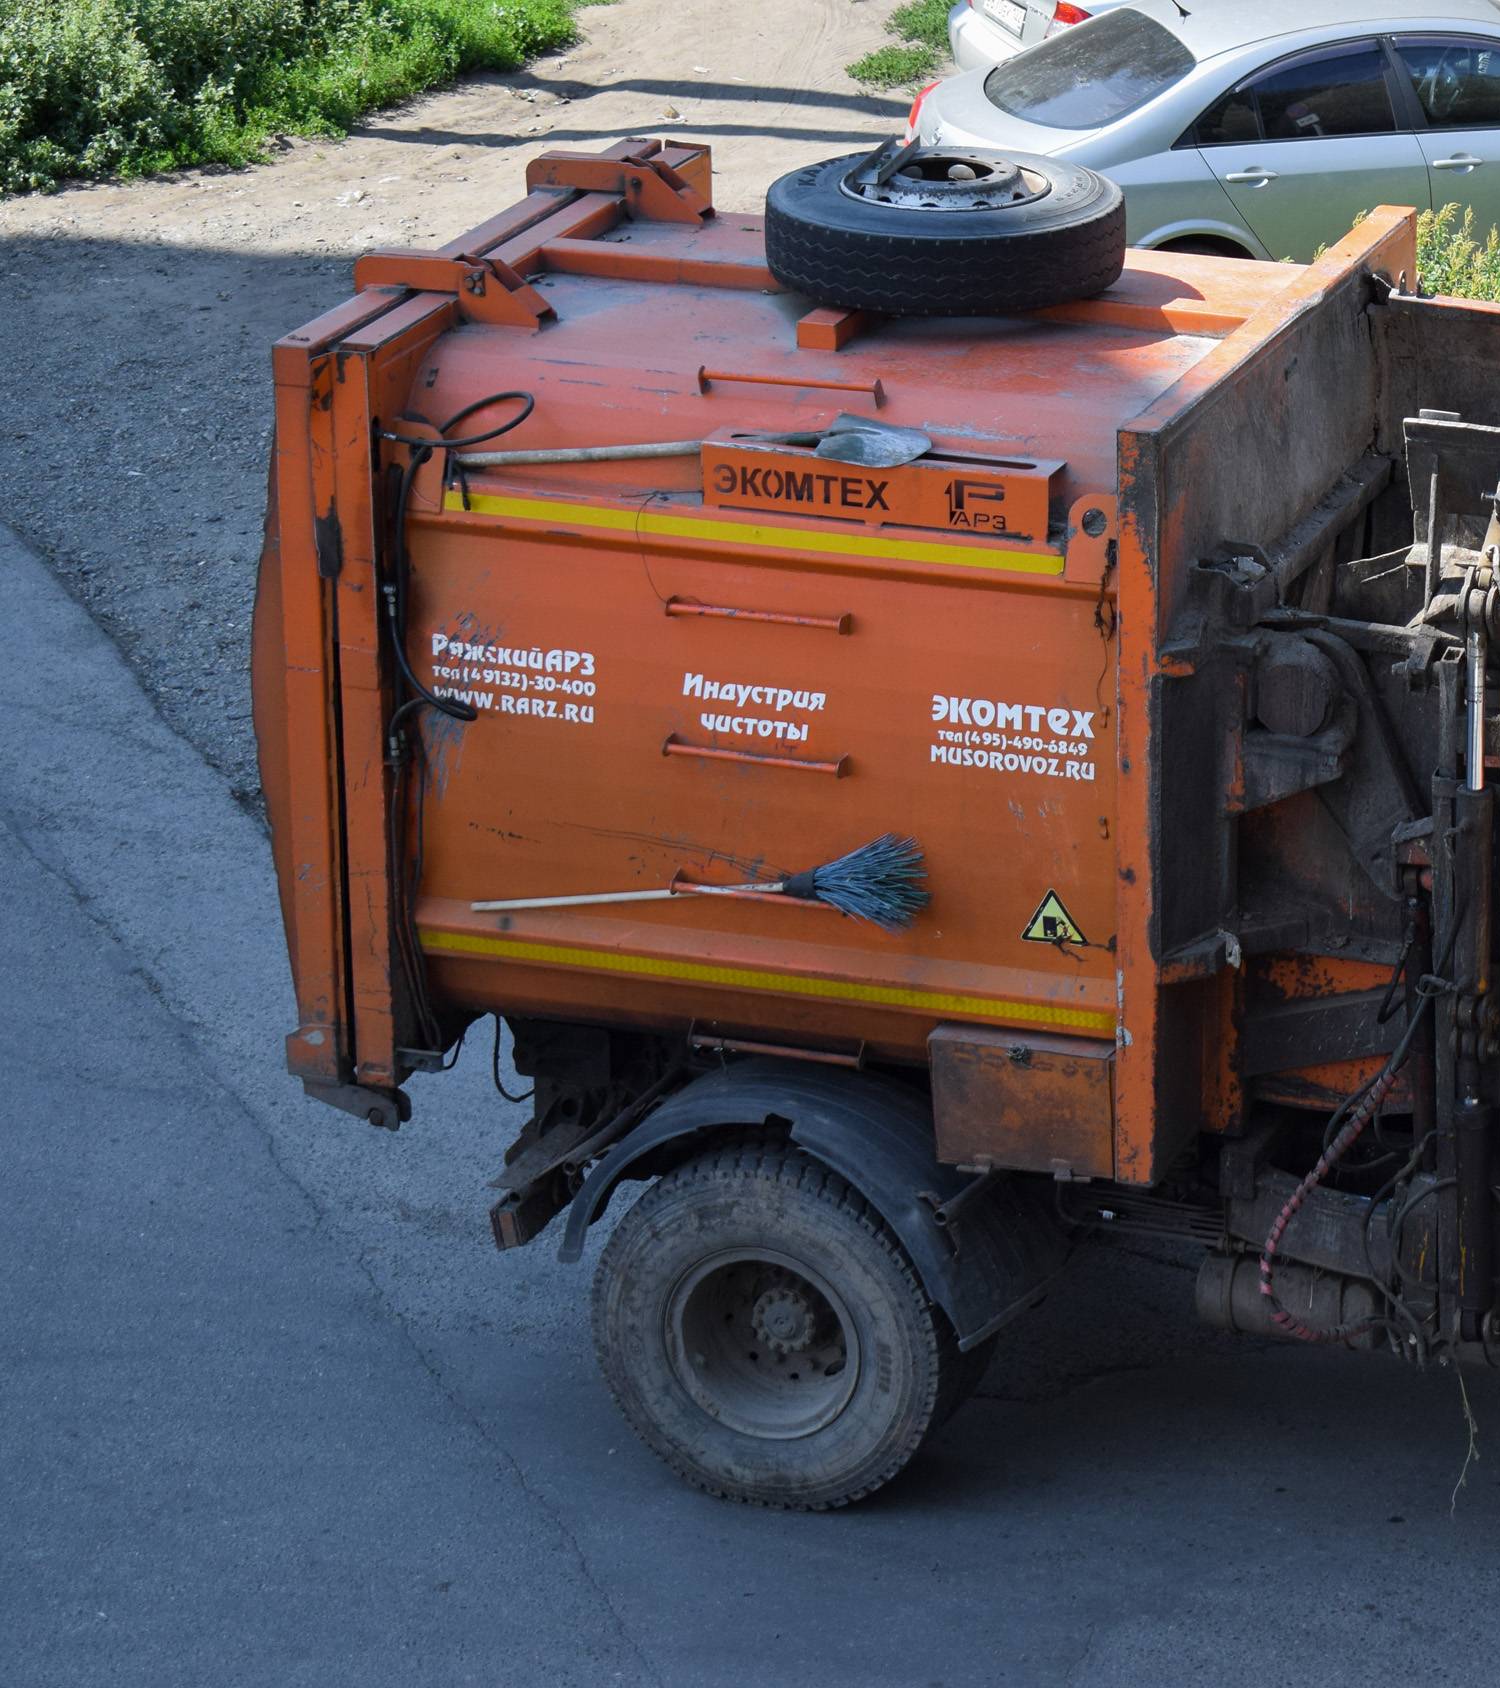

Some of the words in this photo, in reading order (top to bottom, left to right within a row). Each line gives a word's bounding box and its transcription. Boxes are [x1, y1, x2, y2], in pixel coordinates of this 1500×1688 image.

[713, 463, 889, 511] ЭКОМТЕХ
[682, 673, 826, 711] Индустрия
[701, 713, 809, 741] чистоты
[931, 745, 1095, 780] MUSOROVOZ.RU
